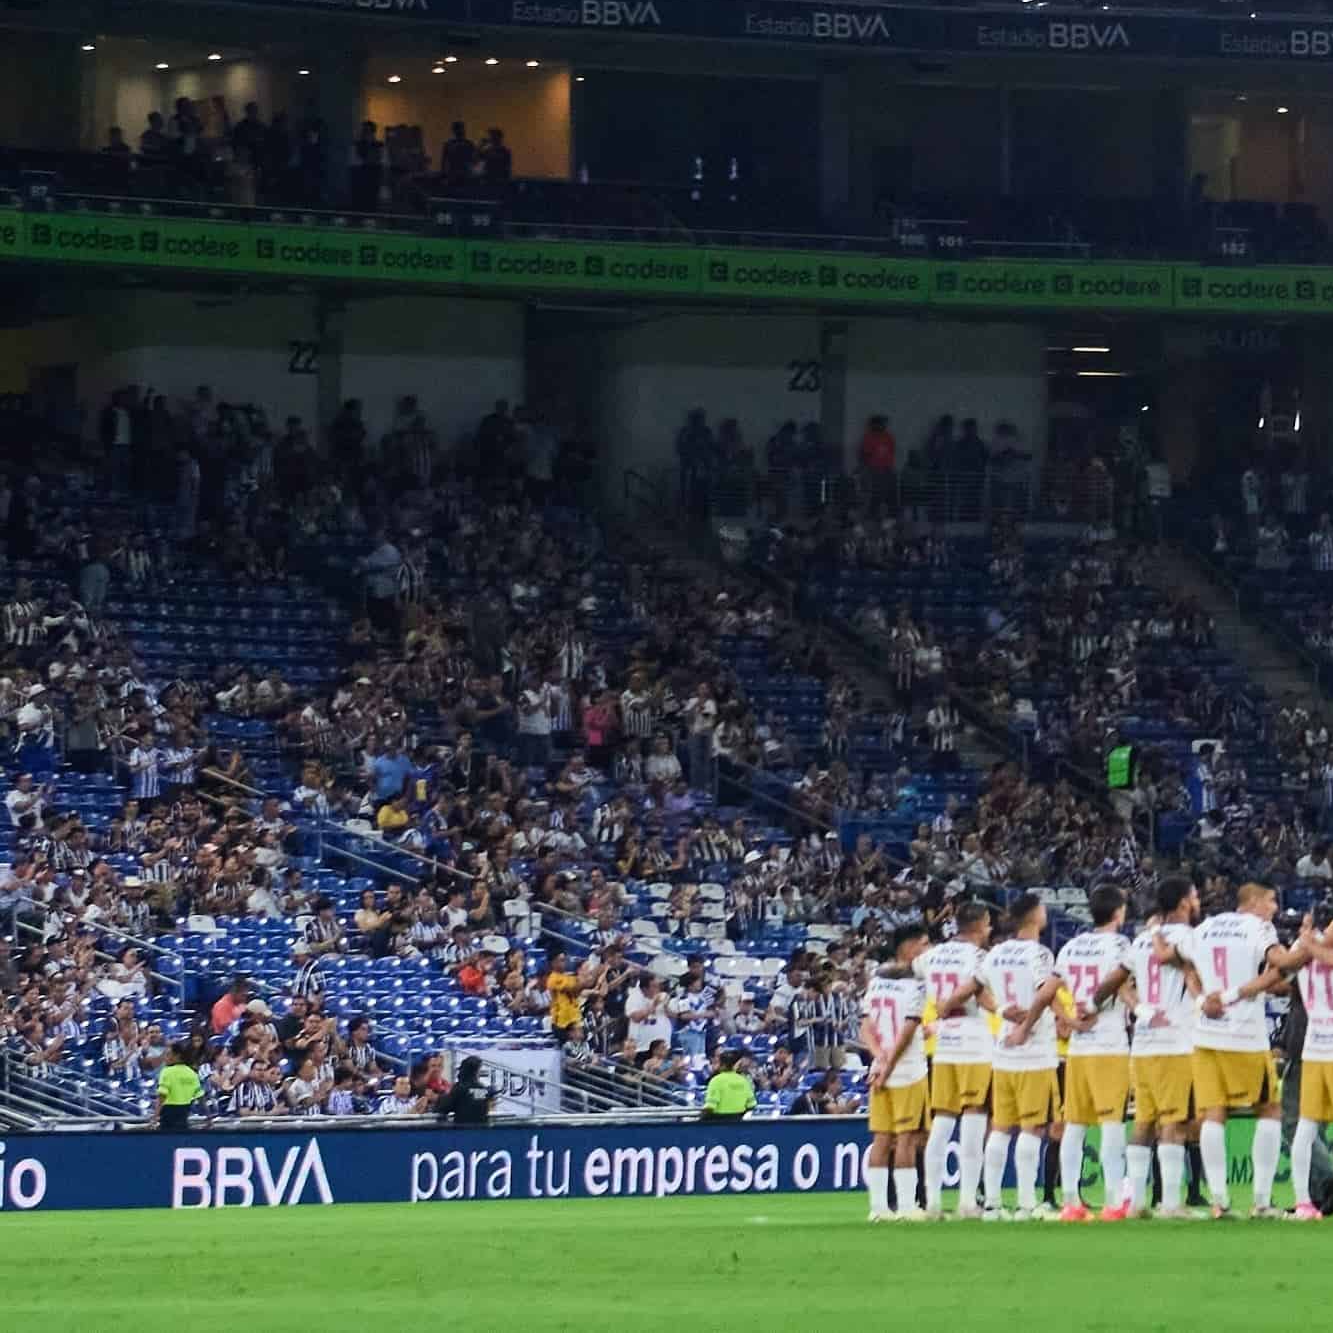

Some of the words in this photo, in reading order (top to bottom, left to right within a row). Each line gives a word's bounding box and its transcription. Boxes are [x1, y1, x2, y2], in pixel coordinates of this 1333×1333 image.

[812, 12, 891, 39] BBVA
[1048, 22, 1131, 50] BBVA
[58, 227, 135, 252] codere
[164, 235, 241, 258] codere
[280, 241, 353, 265] codere
[381, 246, 454, 270] codere
[498, 252, 578, 275] codere
[609, 258, 689, 280] codere
[733, 263, 812, 285] codere
[843, 268, 921, 290] codere
[963, 272, 1046, 295] codere
[1079, 275, 1161, 297] codere
[1206, 279, 1289, 301] codere
[288, 340, 320, 374] 22
[787, 361, 822, 393] 23
[173, 1137, 333, 1208] BBVA
[410, 1149, 513, 1202] para
[528, 1134, 572, 1196] tu
[584, 1142, 779, 1197] empresa
[793, 1144, 820, 1188] o
